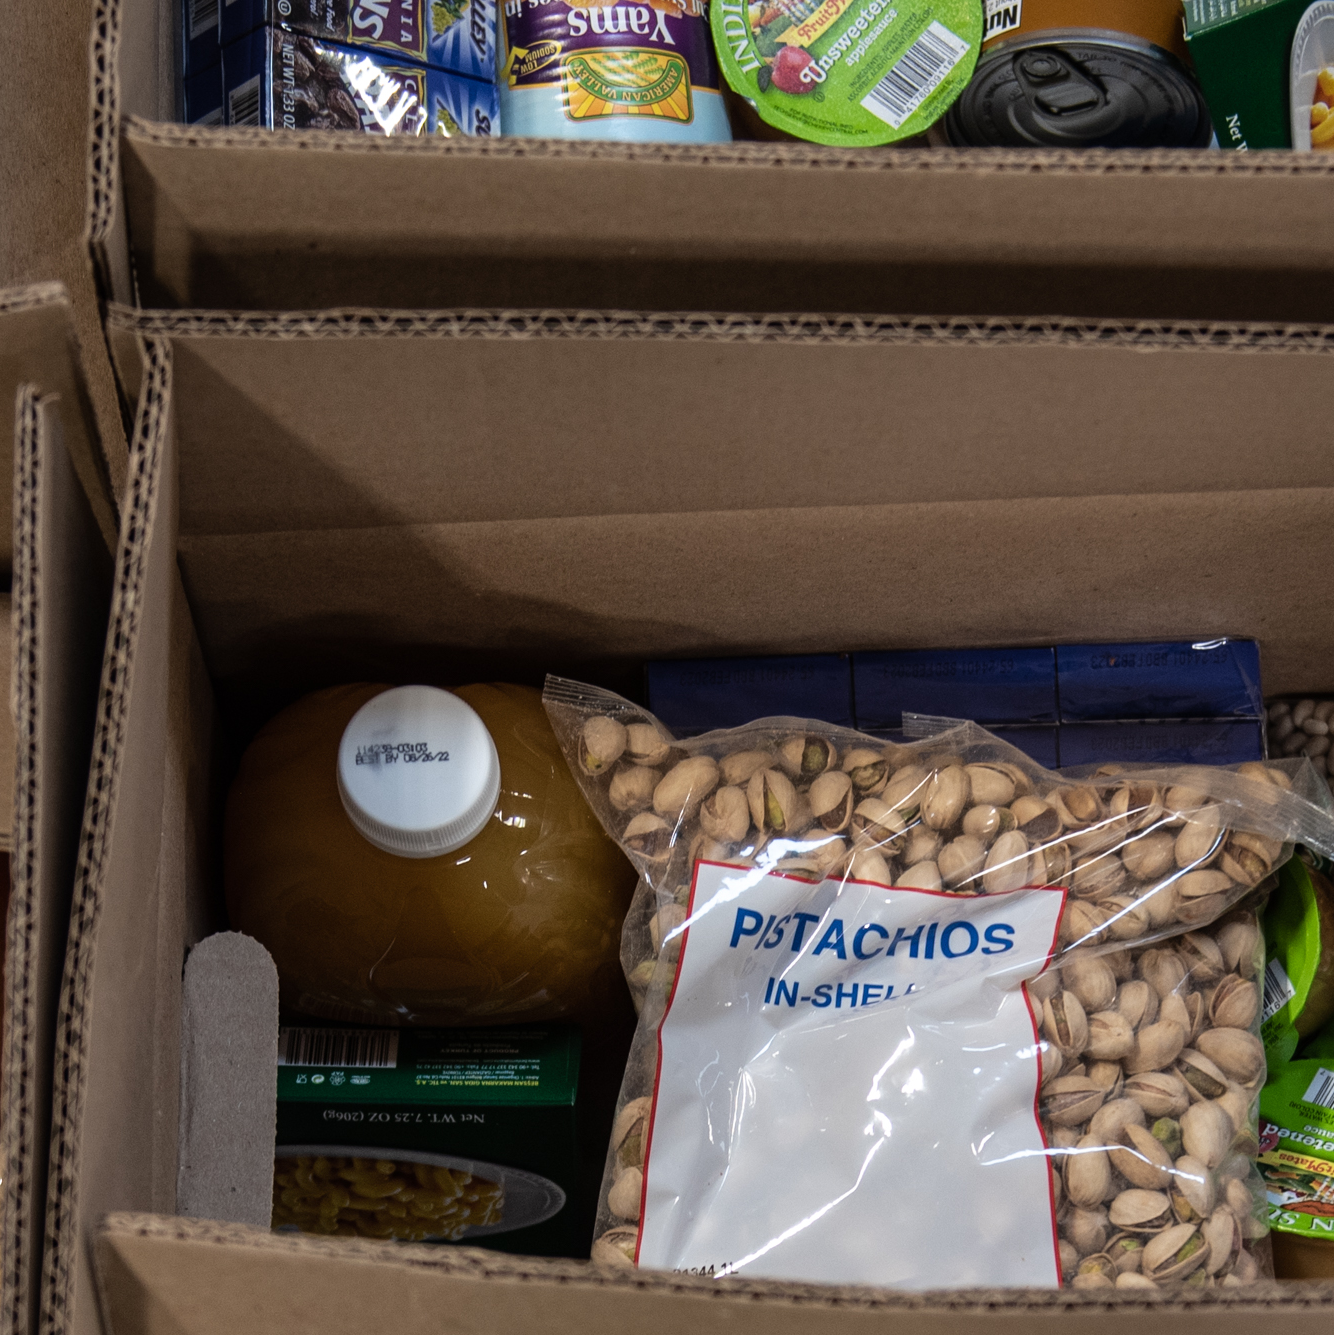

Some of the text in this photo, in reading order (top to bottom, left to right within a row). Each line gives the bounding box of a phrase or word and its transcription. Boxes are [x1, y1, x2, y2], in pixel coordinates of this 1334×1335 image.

[567, 5, 676, 46] Yams
[282, 44, 294, 66] NET
[622, 66, 679, 102] AMERICAN
[1226, 112, 1242, 141] Net
[729, 906, 1017, 961] PISTACHIOS
[367, 1111, 391, 1123] OZ
[394, 1111, 422, 1123] 7.25
[425, 1112, 457, 1124] WT.
[463, 1112, 486, 1124] Net
